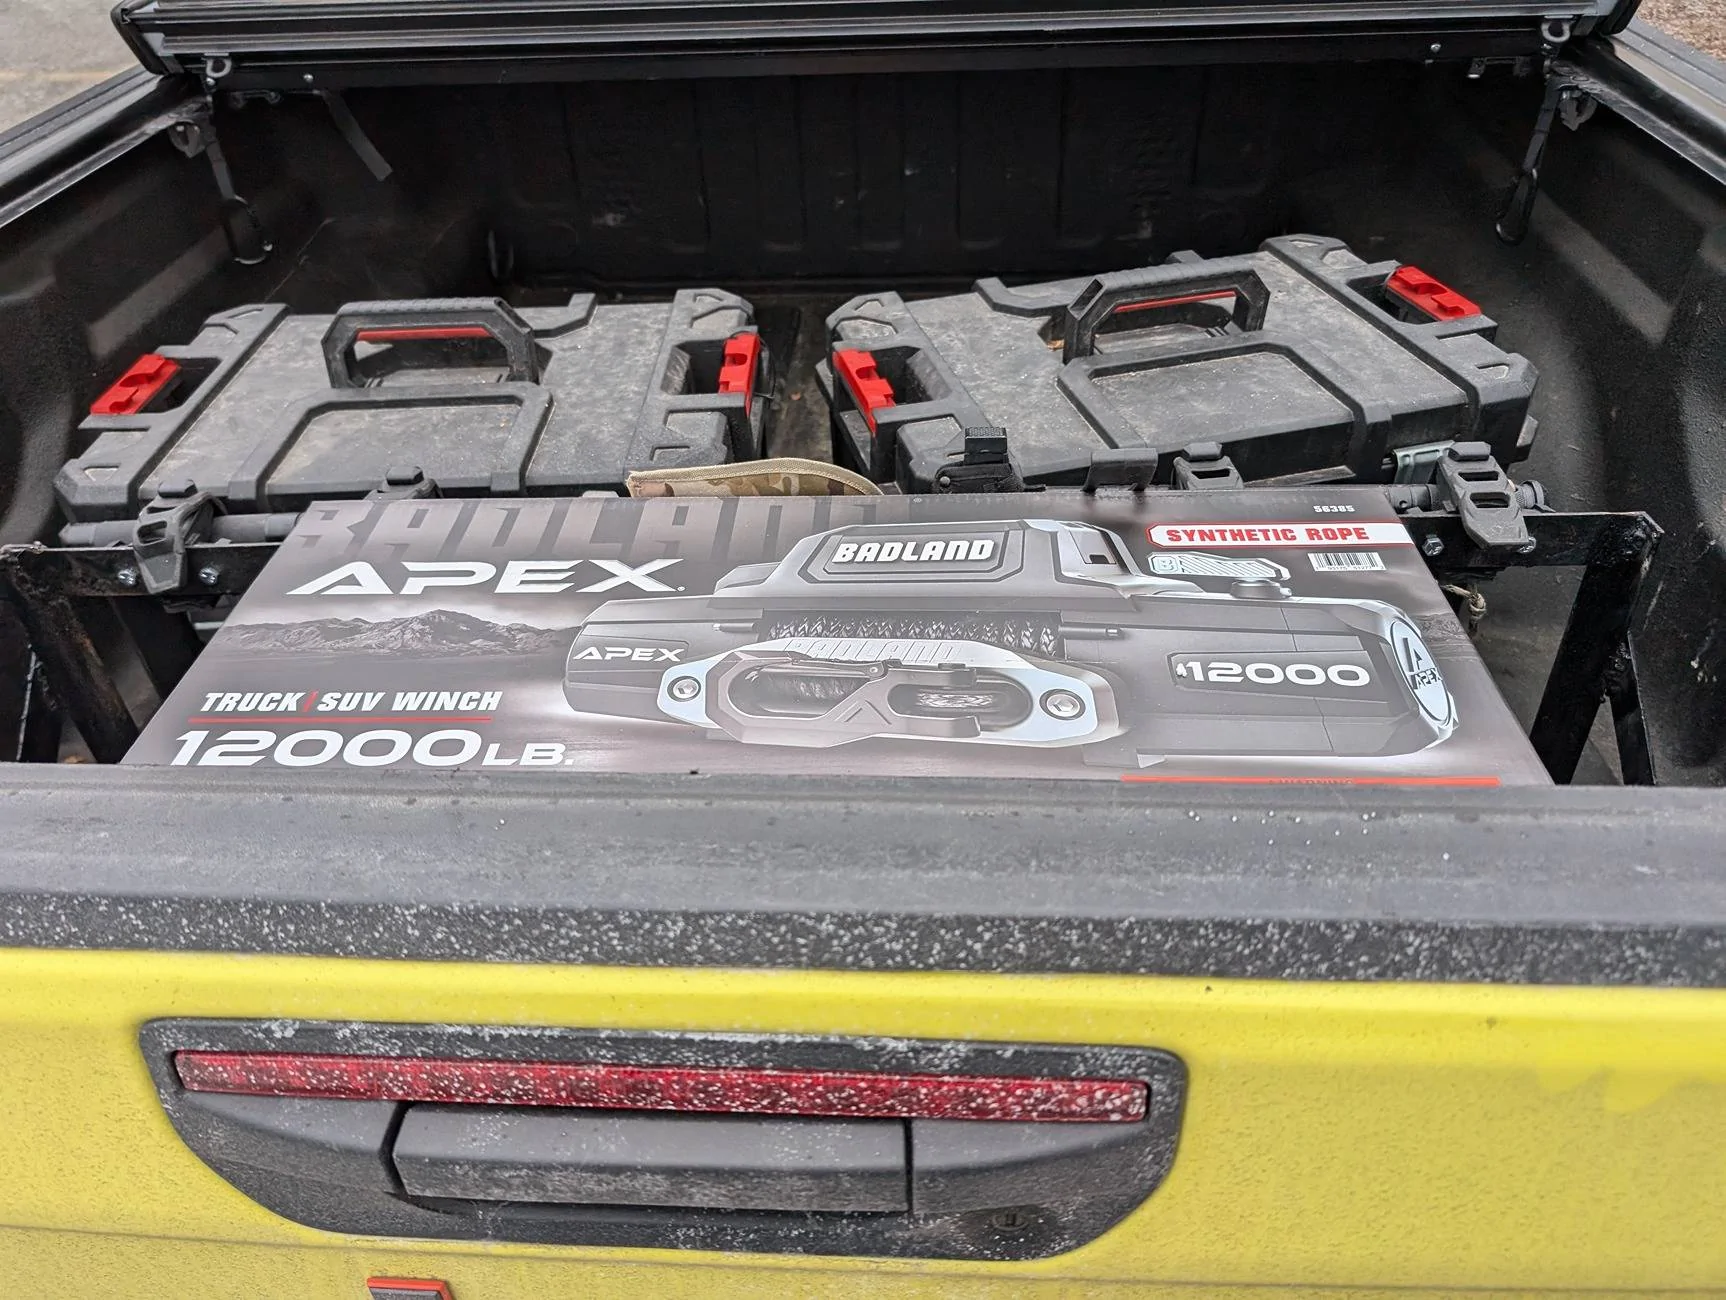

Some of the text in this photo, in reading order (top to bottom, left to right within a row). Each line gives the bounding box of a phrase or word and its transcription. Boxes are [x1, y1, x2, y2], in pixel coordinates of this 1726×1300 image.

[1166, 527, 1369, 542] SYNTHETIC ROPE
[831, 539, 995, 564] BADLAND
[573, 645, 685, 662] APEX
[1185, 661, 1371, 687] 12000
[391, 691, 503, 712] WINCH
